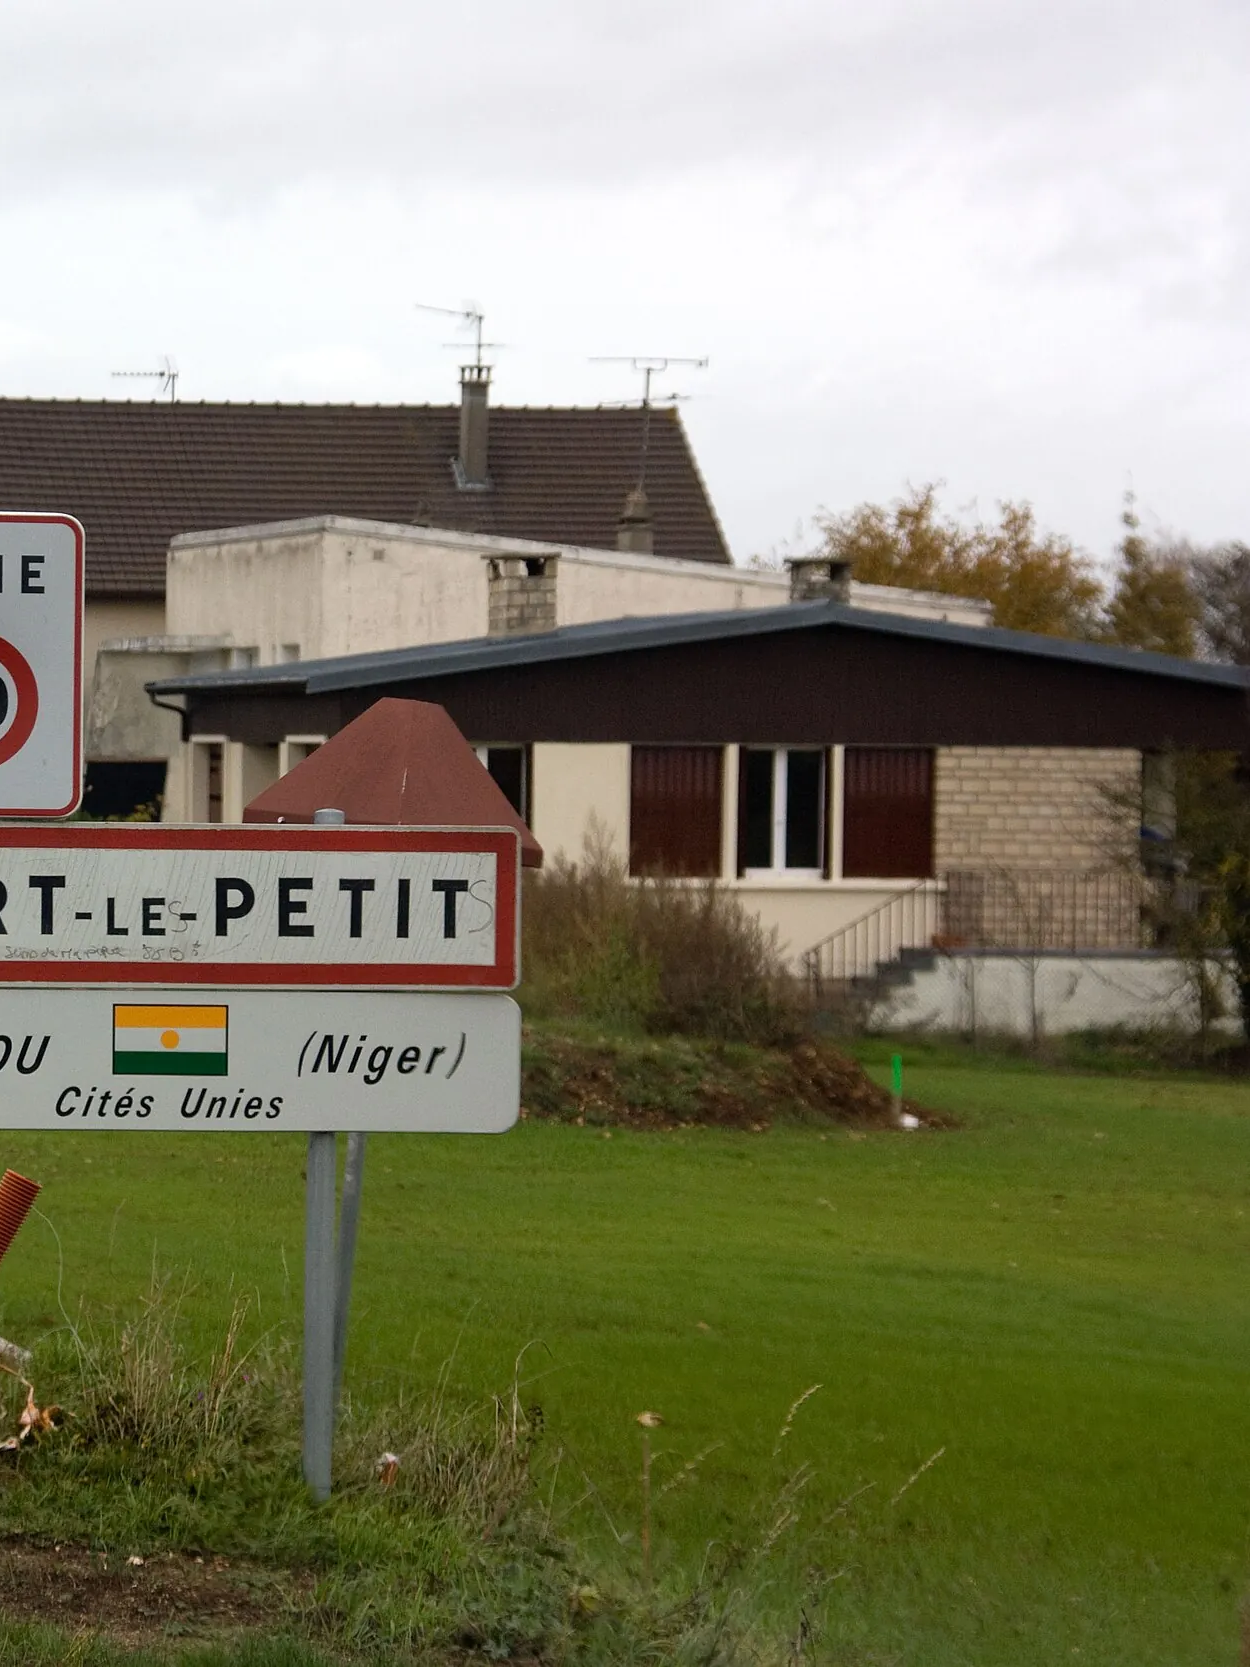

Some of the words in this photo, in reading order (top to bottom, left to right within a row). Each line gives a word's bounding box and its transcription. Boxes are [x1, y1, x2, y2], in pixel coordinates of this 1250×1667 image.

[297, 1030, 467, 1085] (Niger)
[54, 1085, 155, 1118] Cités
[180, 1087, 284, 1119] Unies
